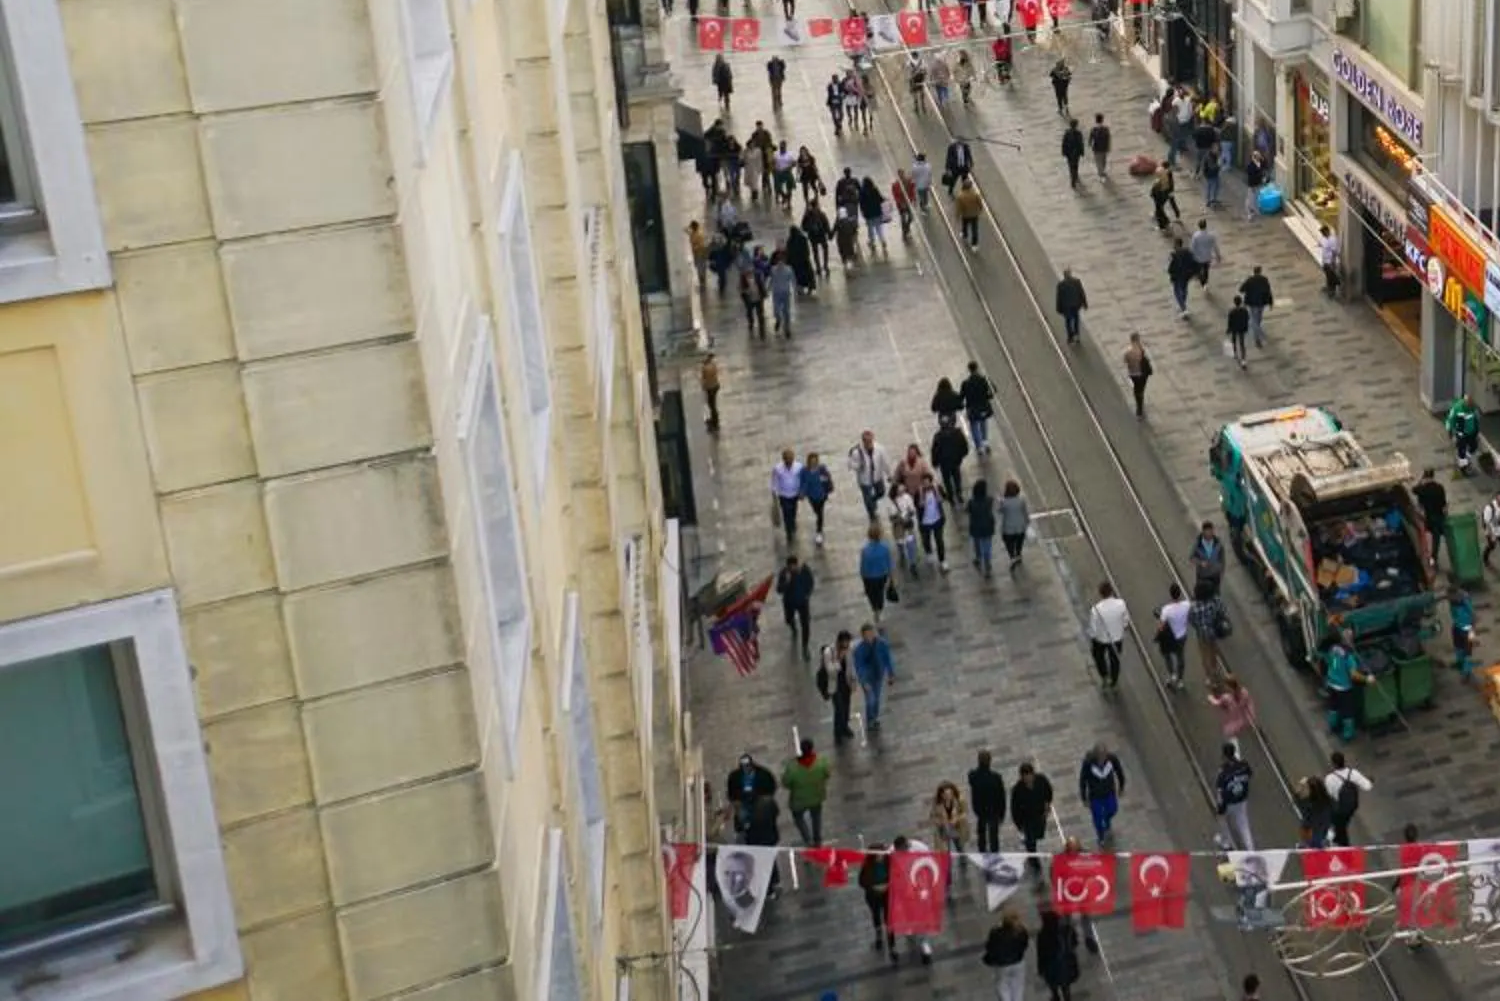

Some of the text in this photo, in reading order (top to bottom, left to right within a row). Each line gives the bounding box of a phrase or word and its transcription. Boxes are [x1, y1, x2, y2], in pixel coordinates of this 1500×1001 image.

[1333, 48, 1423, 149] GOLDEN ROSE
[1405, 238, 1427, 274] KFC
